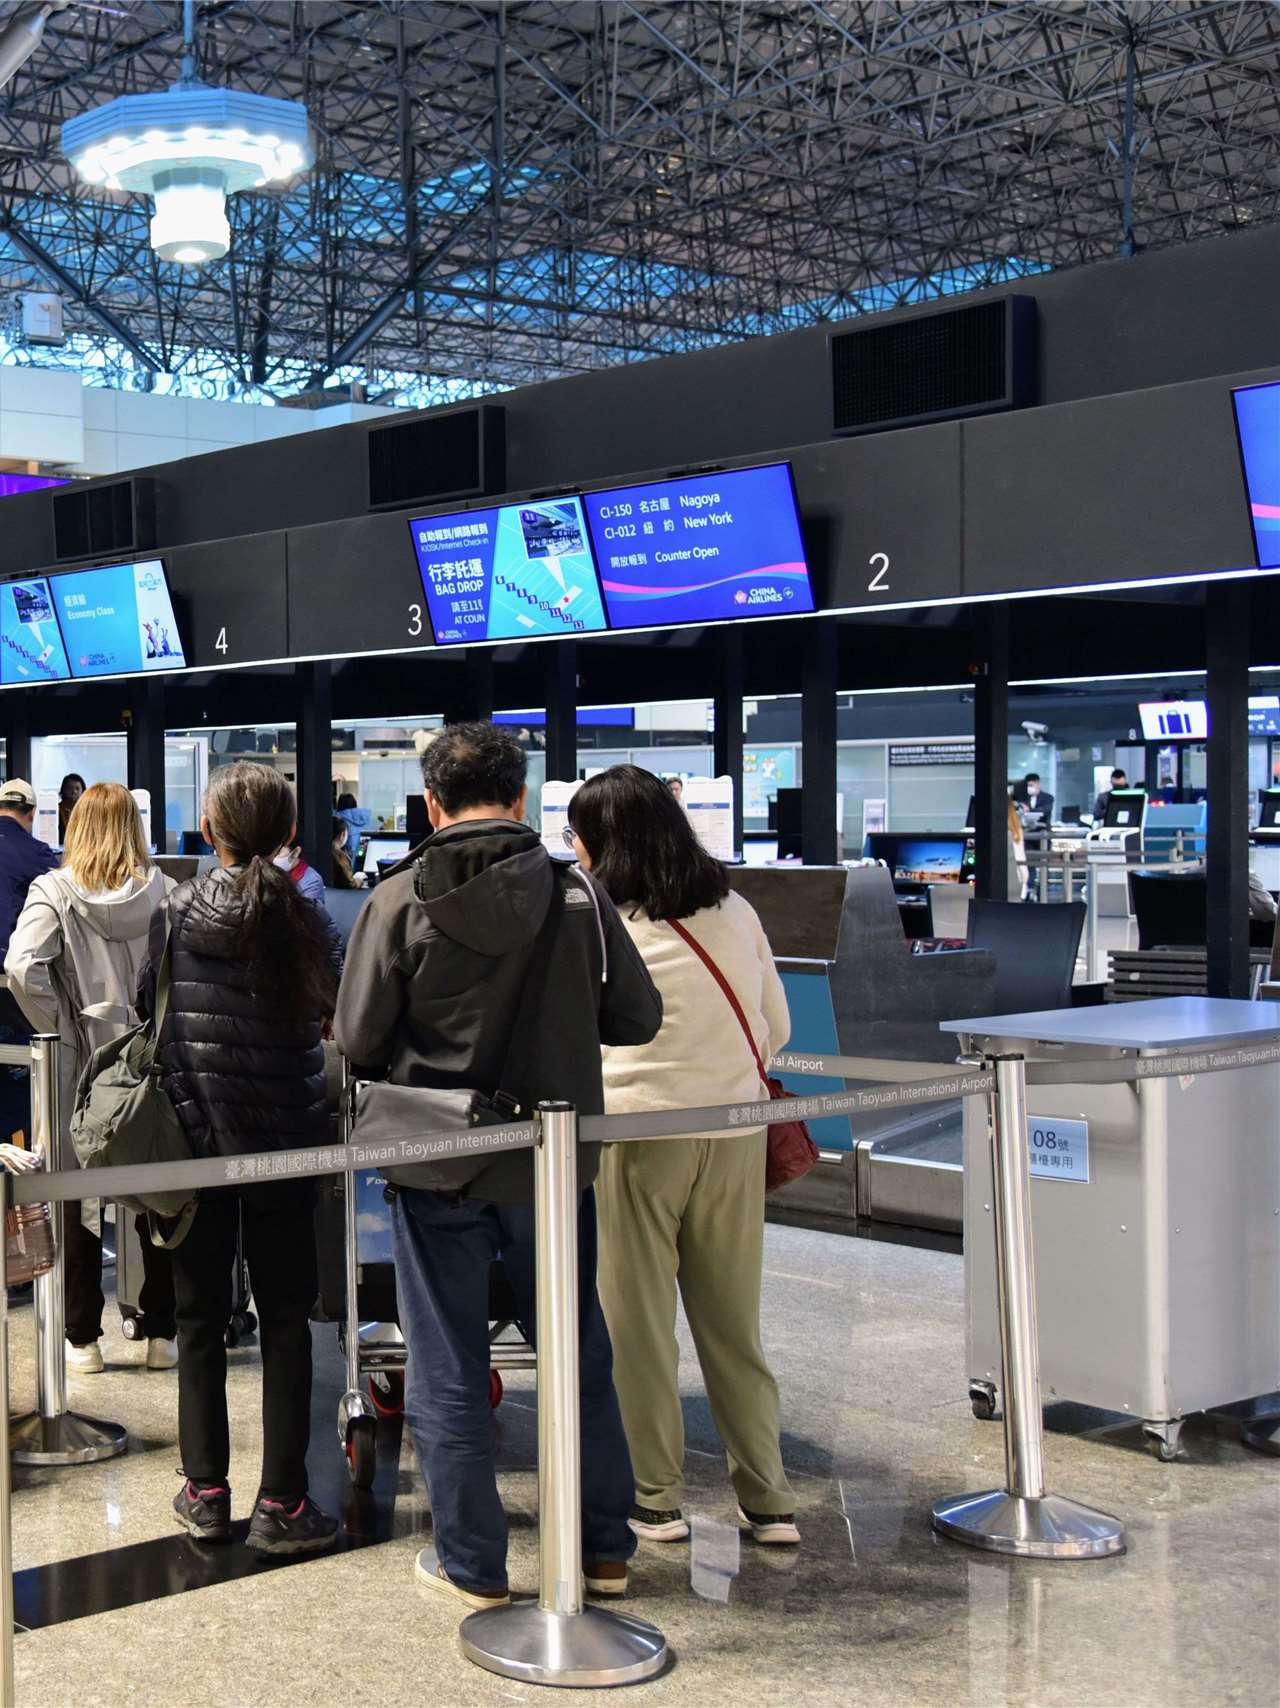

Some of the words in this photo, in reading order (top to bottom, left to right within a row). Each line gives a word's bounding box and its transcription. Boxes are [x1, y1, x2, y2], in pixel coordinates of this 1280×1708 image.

[600, 503, 632, 519] CI-150
[639, 497, 670, 513] 名古屋
[680, 492, 721, 509] Nagoya
[604, 524, 637, 540] CI-012
[684, 515, 707, 529] New
[708, 511, 733, 526] York
[611, 553, 648, 568] 開放報到
[655, 548, 691, 563] Counter
[693, 546, 720, 559] Open
[428, 558, 484, 582] 行李託運
[868, 552, 889, 591] 2
[435, 582, 456, 596] BAG
[457, 579, 484, 594] DROP
[747, 594, 783, 605] AIRLINES
[749, 587, 776, 597] CHINA
[67, 608, 96, 620] Economy
[96, 606, 115, 616] Class
[408, 604, 422, 635] 3
[215, 627, 228, 655] 4
[787, 1055, 824, 1073] Airport
[1208, 1053, 1236, 1066] Taiwan
[822, 1096, 856, 1113] Taiwan
[857, 1090, 898, 1108] Taoyuan
[900, 1079, 959, 1100] International
[961, 1075, 993, 1094] Airport
[224, 1147, 348, 1180] 臺灣桃園國際機場
[351, 1145, 396, 1162] Taiwan
[399, 1138, 453, 1159] Taoyuan
[456, 1126, 534, 1150] International
